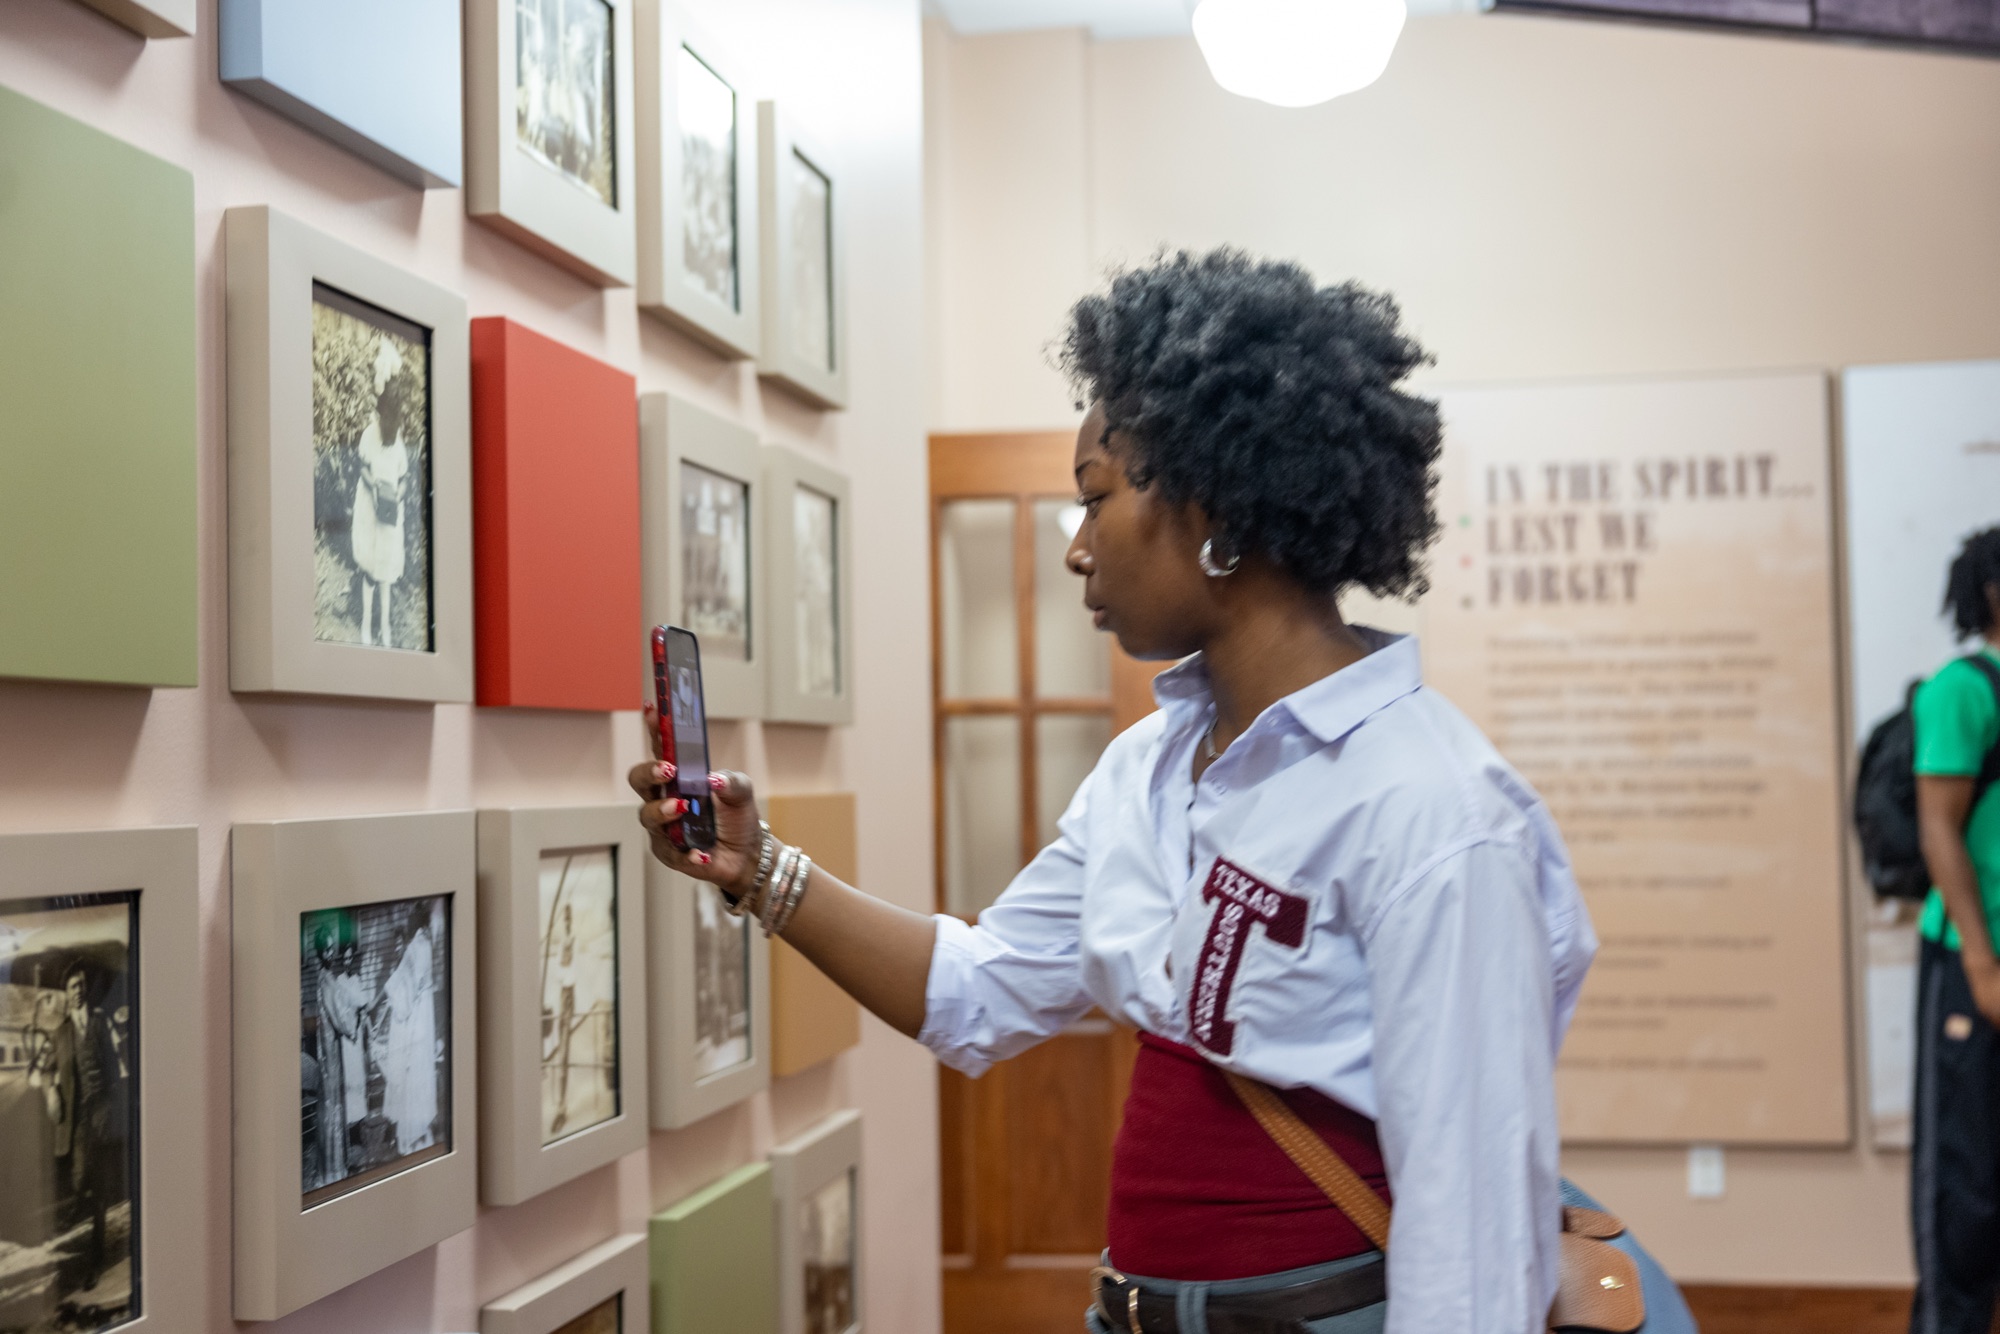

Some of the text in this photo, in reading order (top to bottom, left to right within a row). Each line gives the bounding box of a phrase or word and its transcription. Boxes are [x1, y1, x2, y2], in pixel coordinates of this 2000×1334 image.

[1486, 463, 1528, 504] IN
[1542, 460, 1618, 502] THE
[1486, 510, 1657, 555] LEST WE
[1487, 560, 1641, 607] FORGET
[1212, 863, 1281, 919] TEXAS
